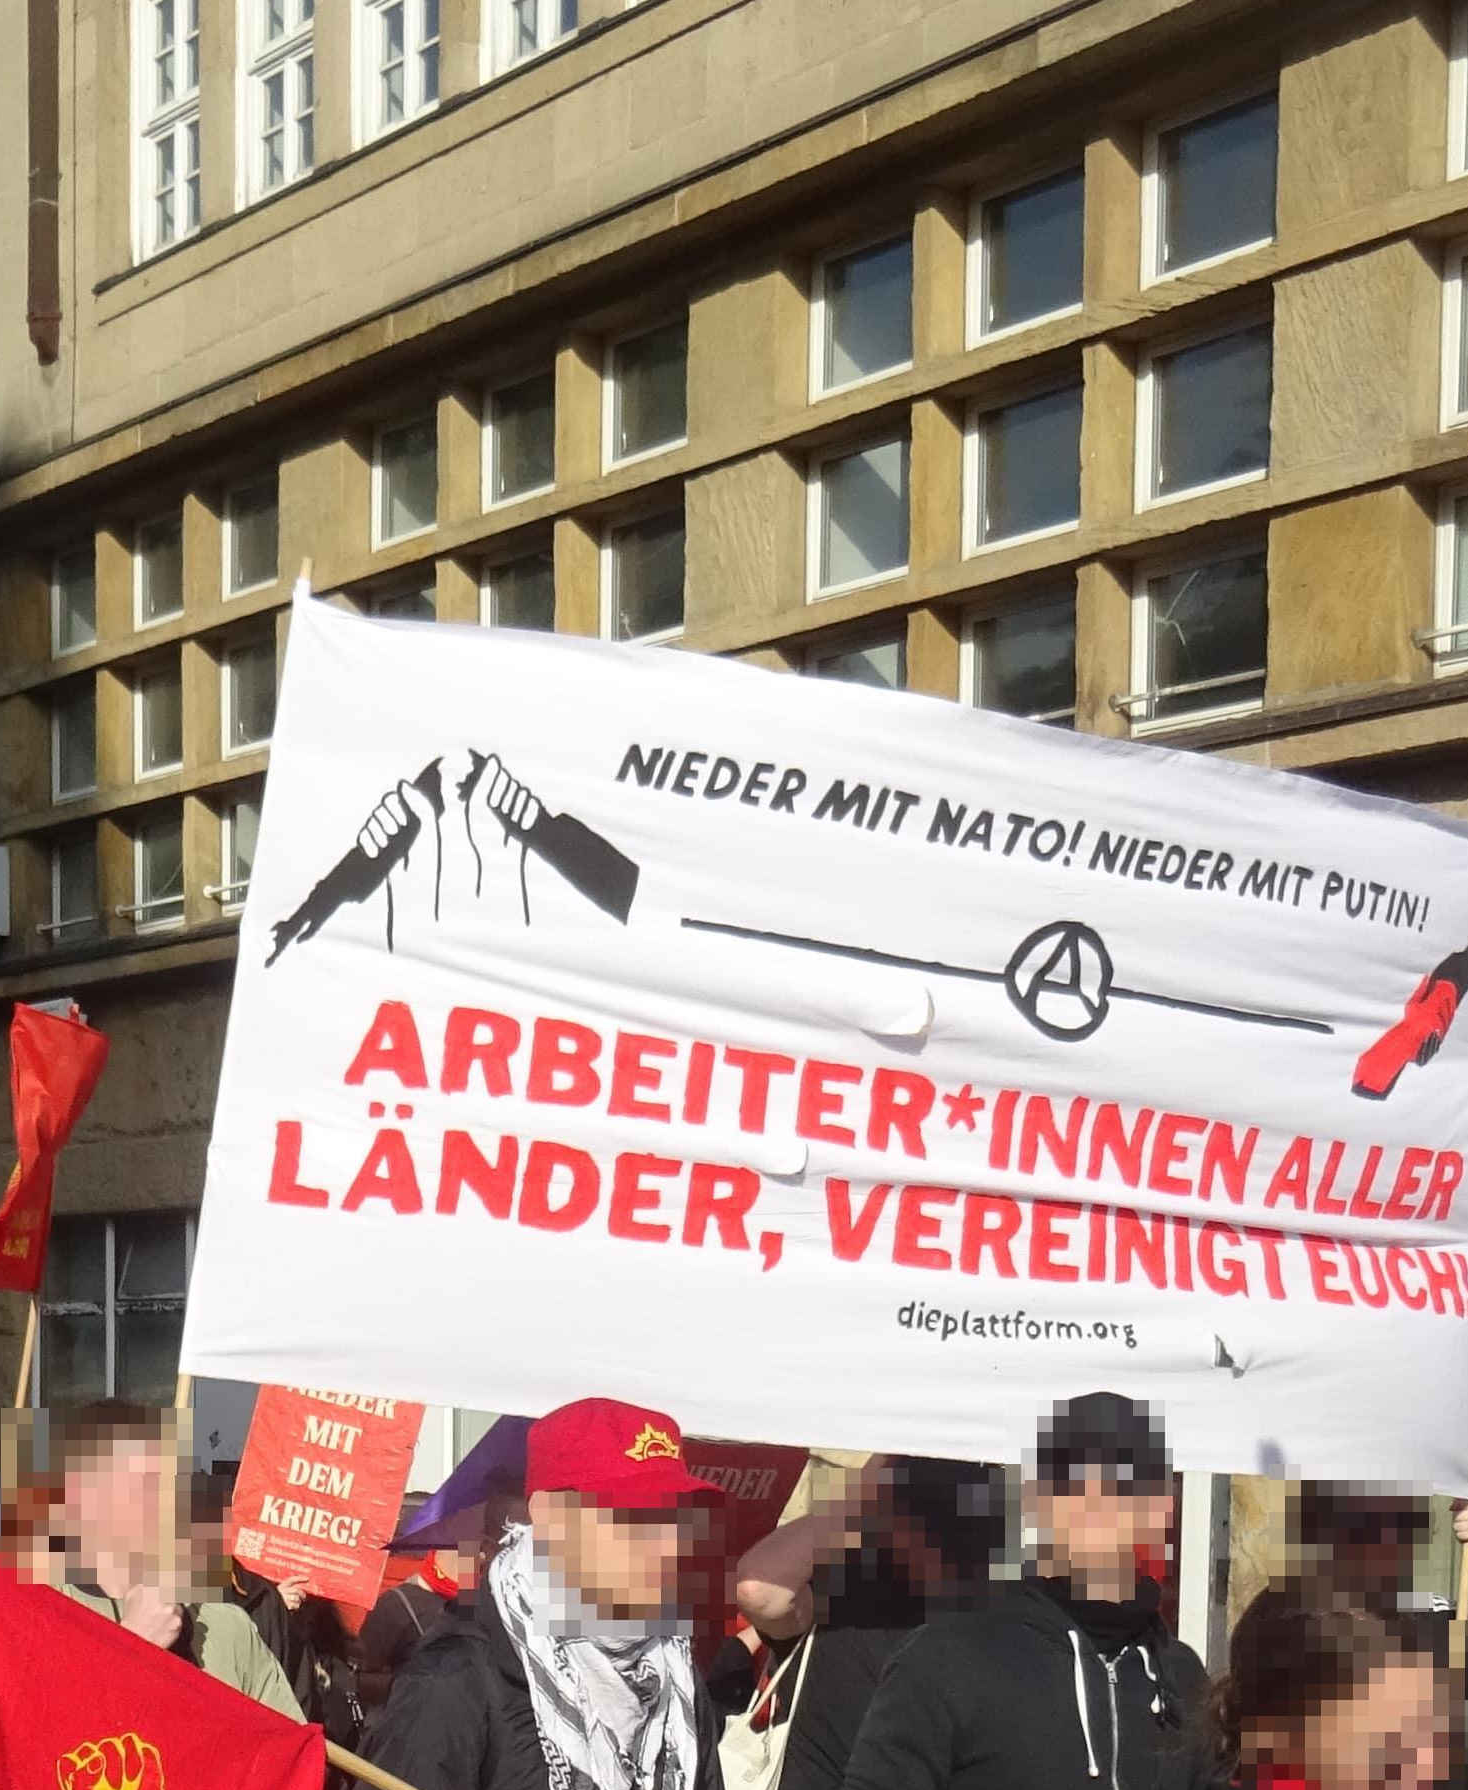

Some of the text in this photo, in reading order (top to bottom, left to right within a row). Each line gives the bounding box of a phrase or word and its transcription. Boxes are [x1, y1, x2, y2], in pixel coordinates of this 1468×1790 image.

[614, 743, 1431, 932] NIEDER MIT NATO! NIEDER MIT PUTIN!
[267, 1101, 784, 1273] LÄNDER,
[824, 1176, 1303, 1302] VEREINIGT
[1263, 1136, 1466, 1222] ALLER
[897, 1301, 1138, 1349] dieplattform.org
[302, 1414, 363, 1455] MIT
[286, 1456, 355, 1500] DEM
[259, 1494, 363, 1548] KRIEG!
